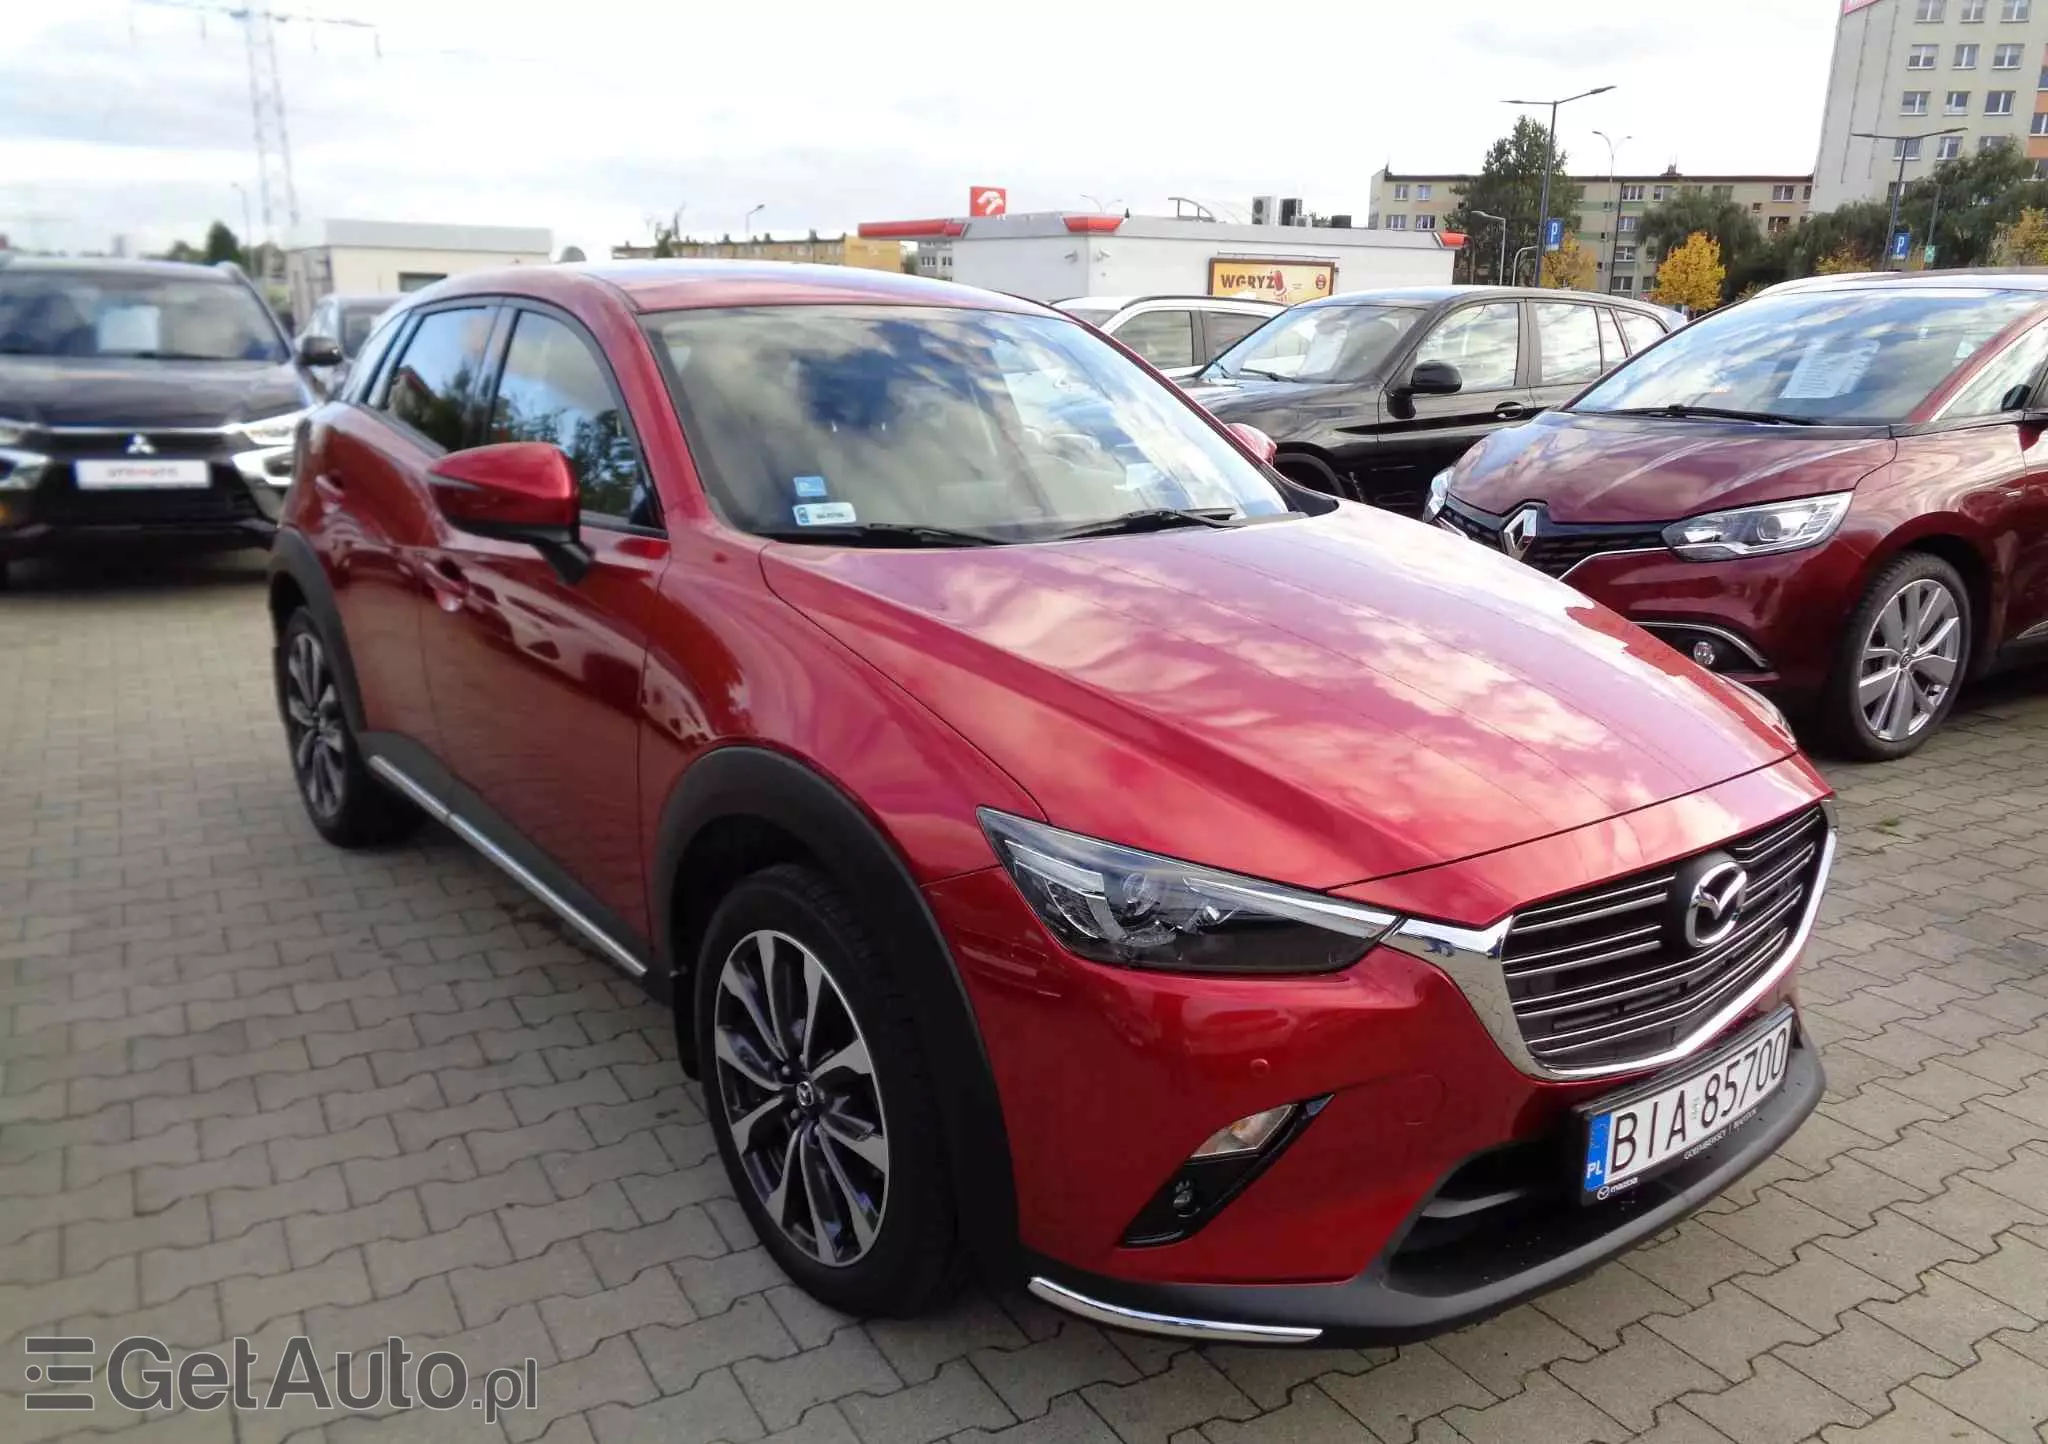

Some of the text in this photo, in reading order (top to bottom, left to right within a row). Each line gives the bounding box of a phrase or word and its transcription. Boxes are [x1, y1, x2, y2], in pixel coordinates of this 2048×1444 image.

[1610, 1027, 1787, 1174] BIA 85700
[1586, 1160, 1603, 1179] PL
